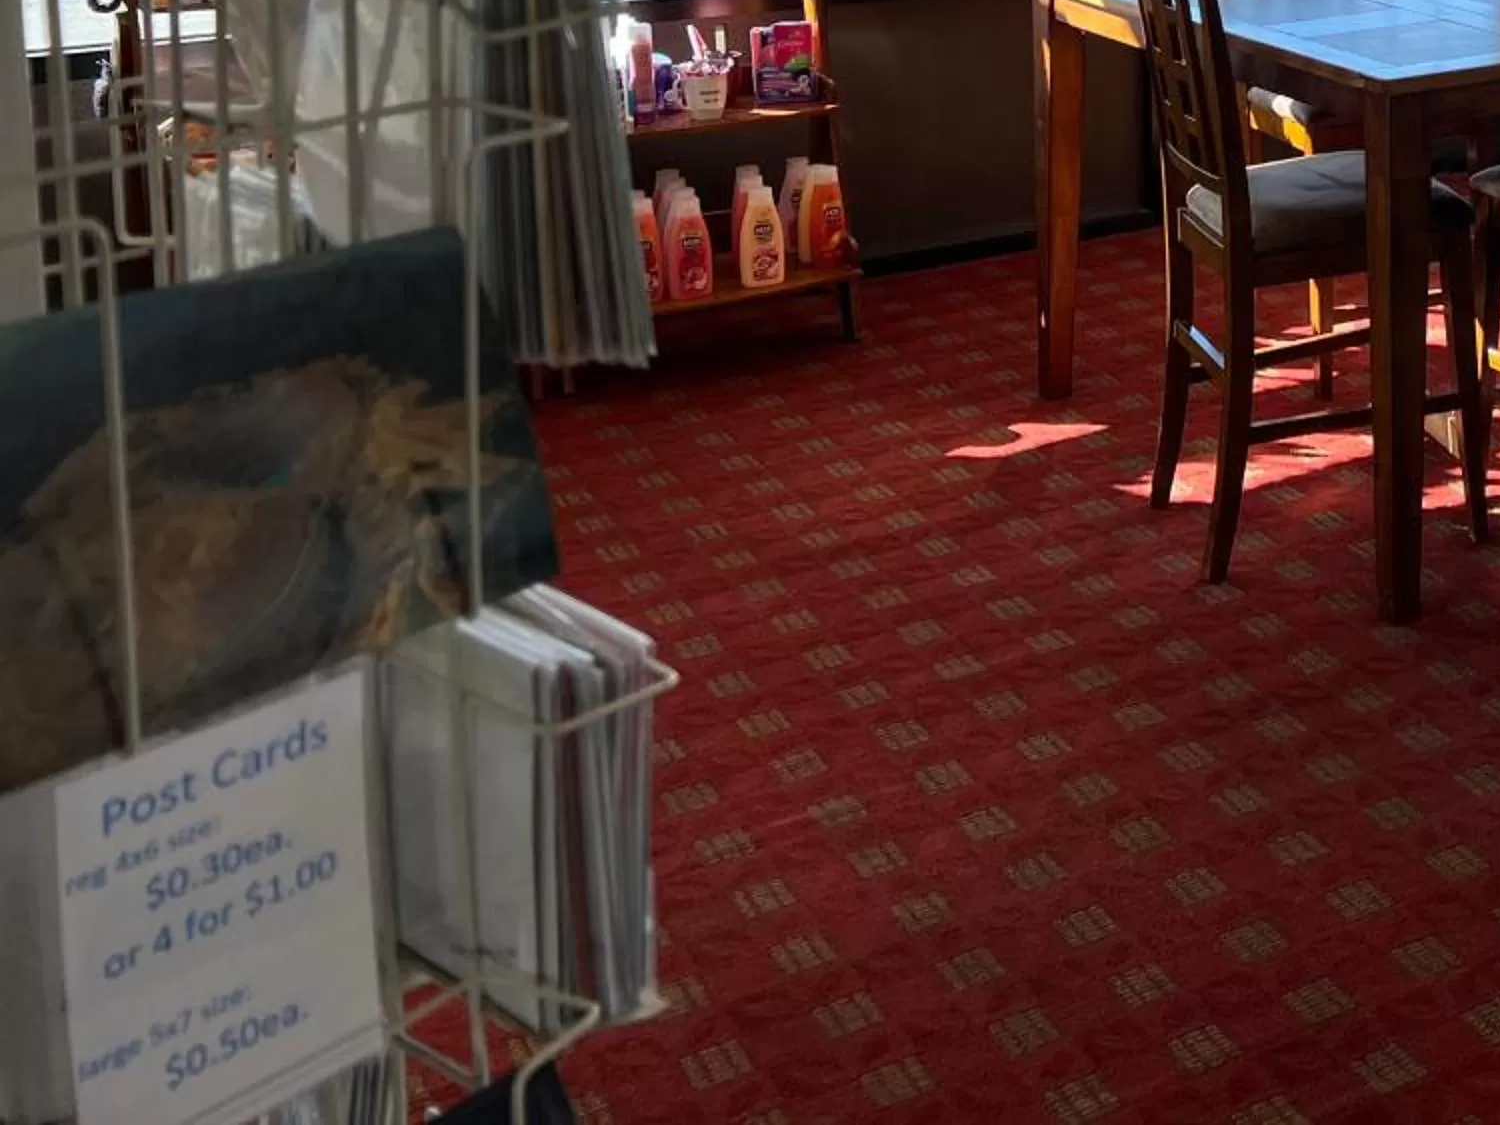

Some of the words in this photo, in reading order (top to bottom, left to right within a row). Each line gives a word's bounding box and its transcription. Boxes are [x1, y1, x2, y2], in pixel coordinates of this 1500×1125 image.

[102, 771, 197, 837] Post
[211, 719, 330, 789] Cards
[65, 865, 108, 897] reg
[115, 838, 160, 873] 4x6
[145, 831, 294, 911] $0.30ea.
[103, 943, 143, 980] or
[152, 924, 173, 955] 4
[185, 901, 234, 942] for
[244, 850, 336, 919] $1.00
[149, 1007, 194, 1049] 5x7
[164, 1002, 311, 1091] $0.50ea.
